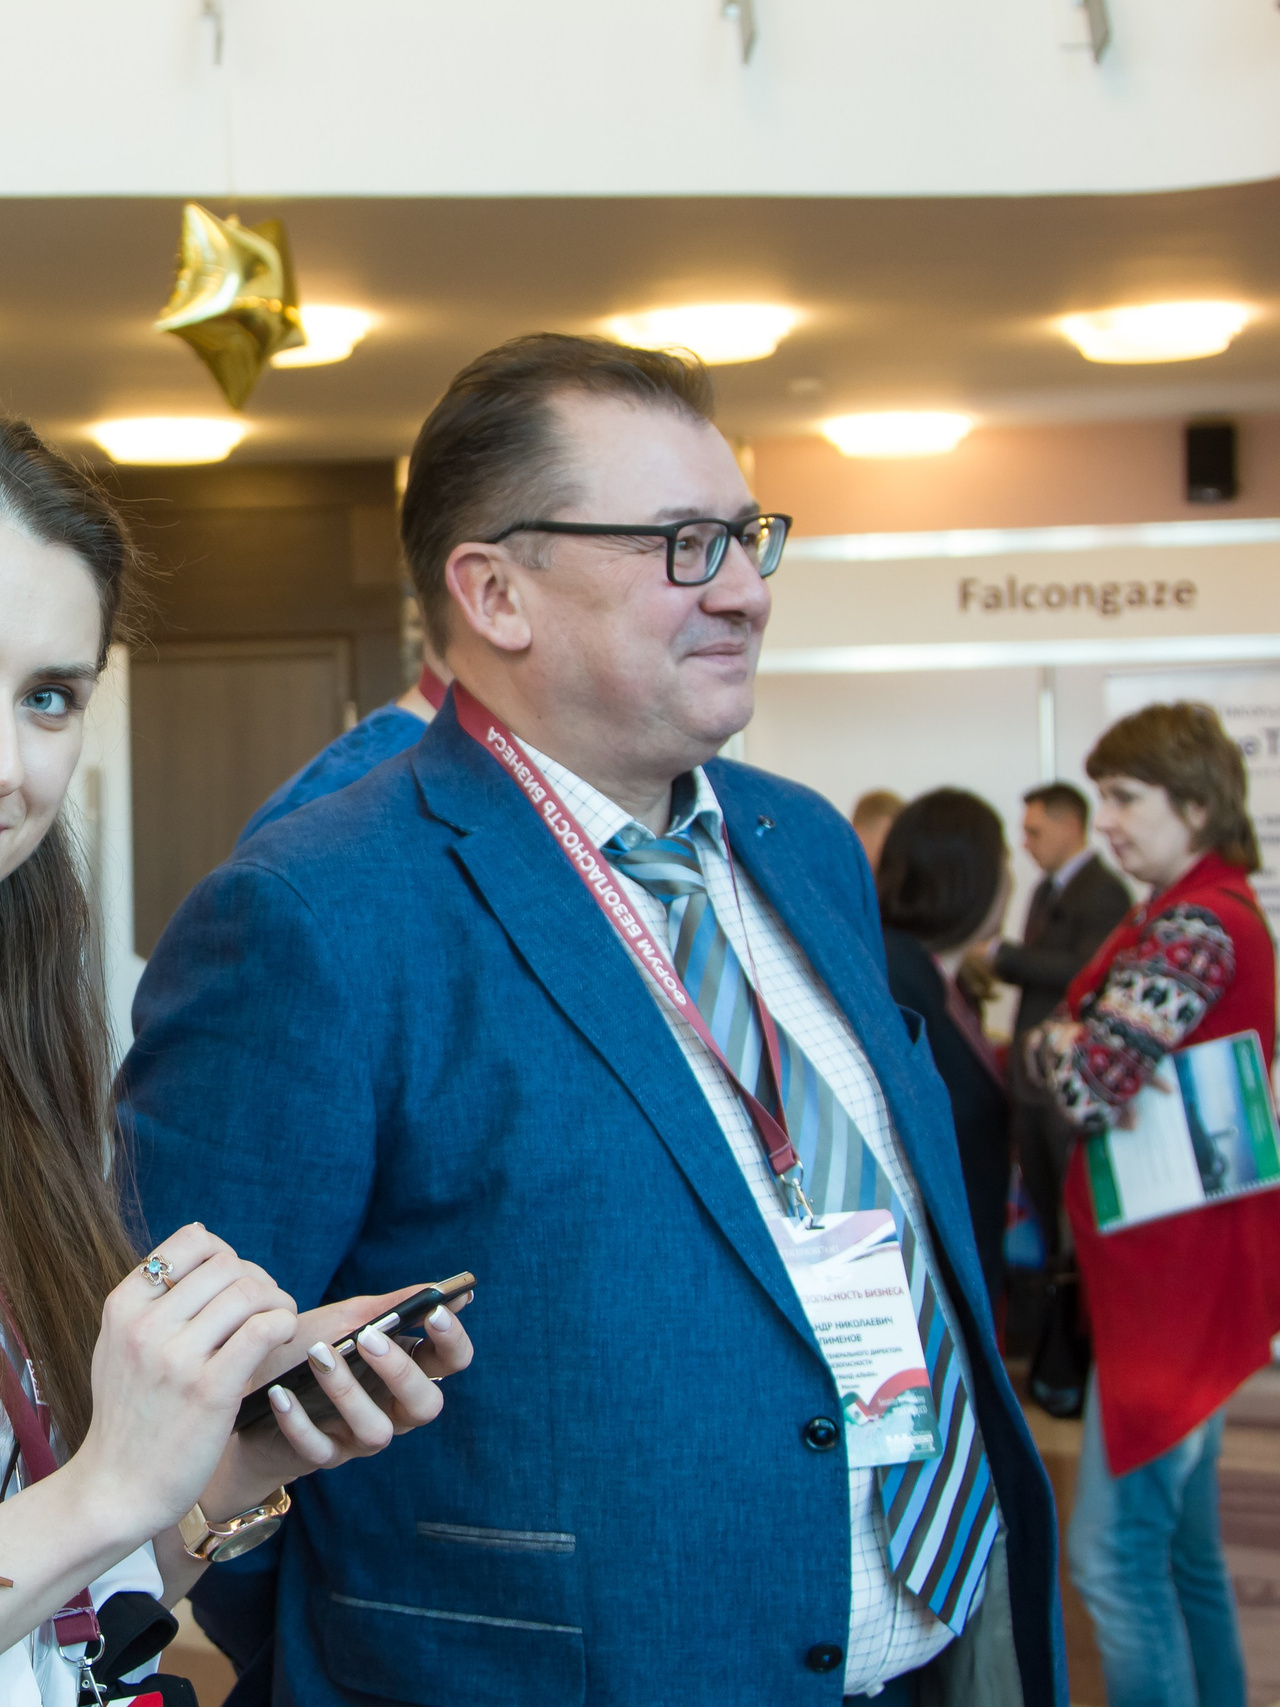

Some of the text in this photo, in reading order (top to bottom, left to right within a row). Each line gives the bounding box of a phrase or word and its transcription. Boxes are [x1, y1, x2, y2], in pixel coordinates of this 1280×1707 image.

[957, 574, 1198, 617] Falcongaze
[486, 726, 687, 1006] ФОРУМ БЕЗОПАСНОСТЬ БИЗНЕСА
[864, 1286, 905, 1299] БИЗНЕСА
[835, 1316, 894, 1330] НИКОЛАЕВИЧ
